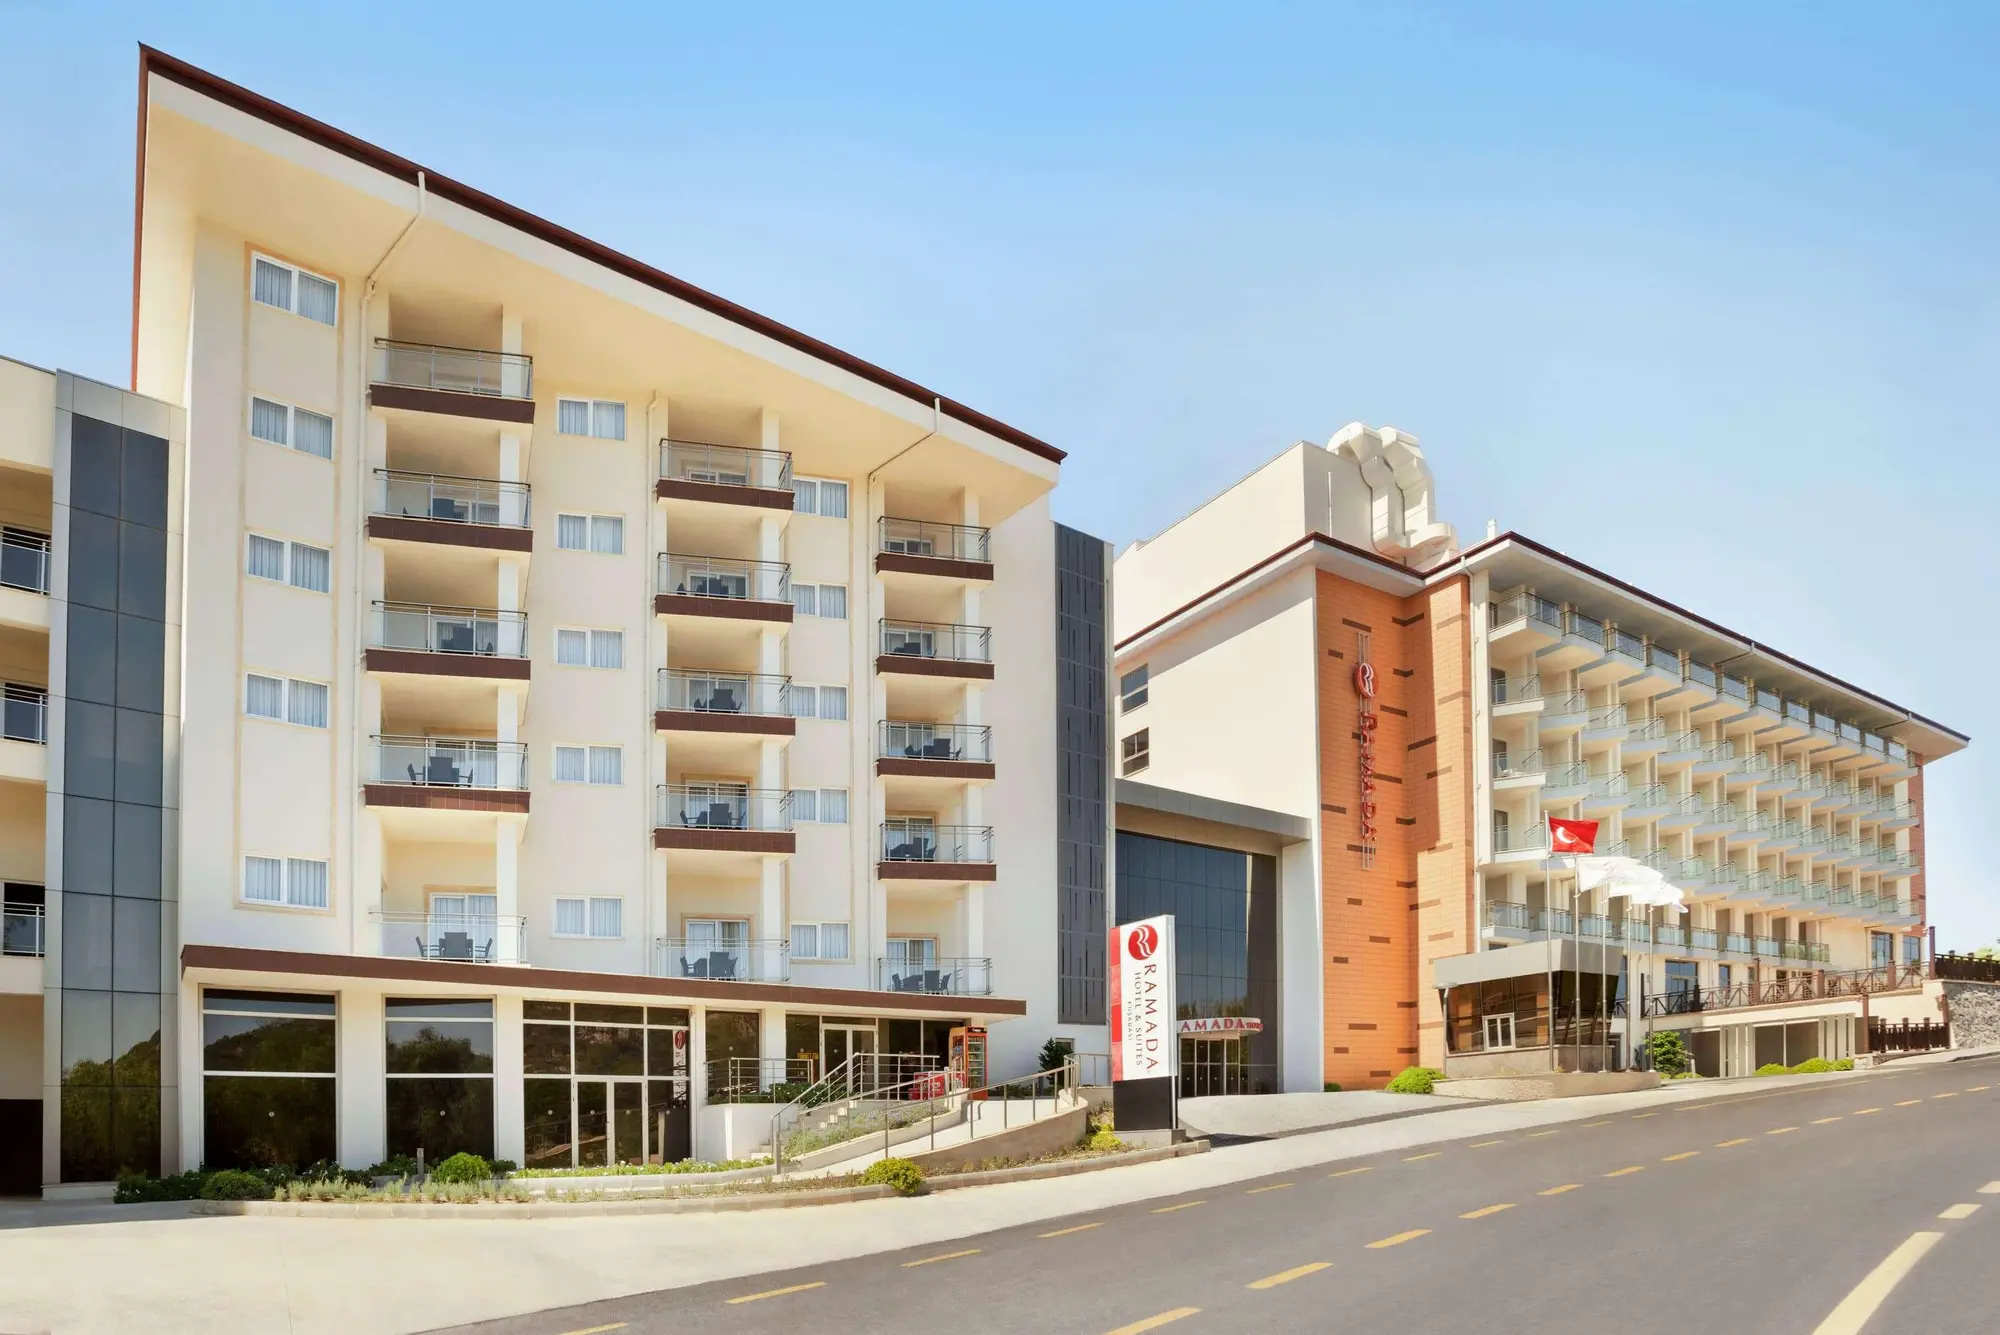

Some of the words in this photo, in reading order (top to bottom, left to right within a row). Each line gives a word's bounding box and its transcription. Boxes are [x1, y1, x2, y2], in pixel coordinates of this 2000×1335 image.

[1360, 711, 1378, 839] RAMADA
[1134, 972, 1143, 1009] HOTEL
[1134, 1014, 1142, 1022] &
[1144, 963, 1159, 1070] RAMADA
[1180, 1018, 1246, 1032] AMADA
[1135, 1027, 1143, 1066] SUITES
